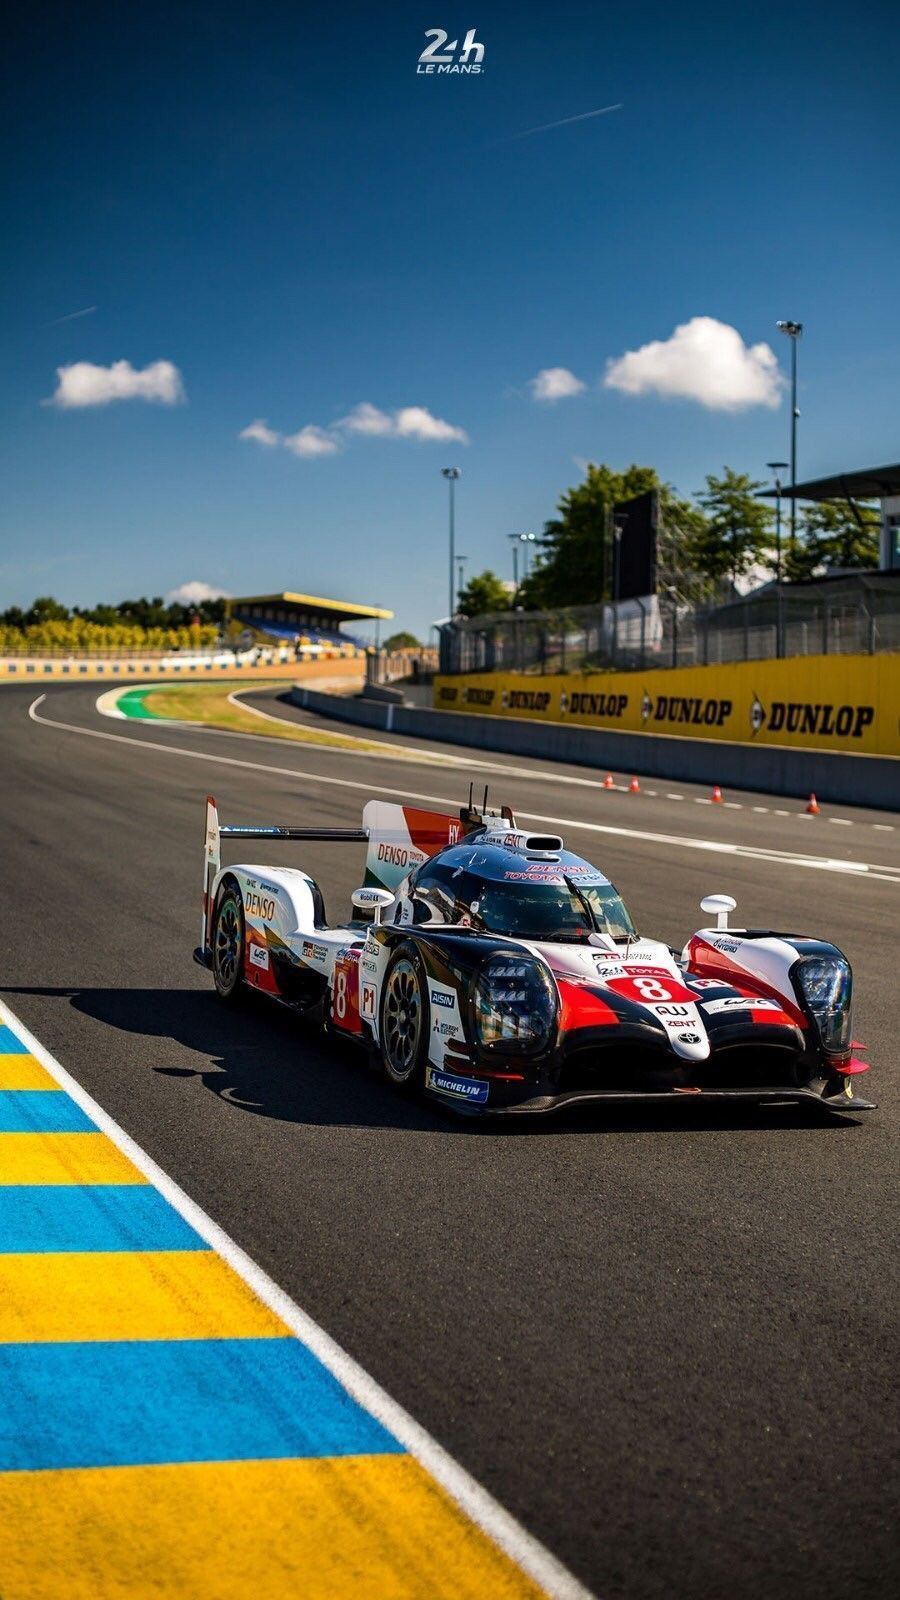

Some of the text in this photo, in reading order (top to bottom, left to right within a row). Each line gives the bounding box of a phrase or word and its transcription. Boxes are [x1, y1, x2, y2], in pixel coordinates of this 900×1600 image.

[509, 690, 551, 712] DUNLOP
[569, 693, 628, 718] DUNLOP
[653, 697, 732, 726] DUNLOP
[767, 702, 874, 738] DUNLOP
[377, 843, 408, 868] DENSO
[245, 891, 275, 921] DENSO
[627, 967, 673, 977] TOTAL
[336, 971, 347, 1019] 8
[362, 987, 374, 1014] P1
[432, 992, 454, 1006] AISIN
[632, 977, 673, 1001] 8
[665, 1019, 697, 1028] ZENT
[437, 1077, 481, 1096] MICHELIN
